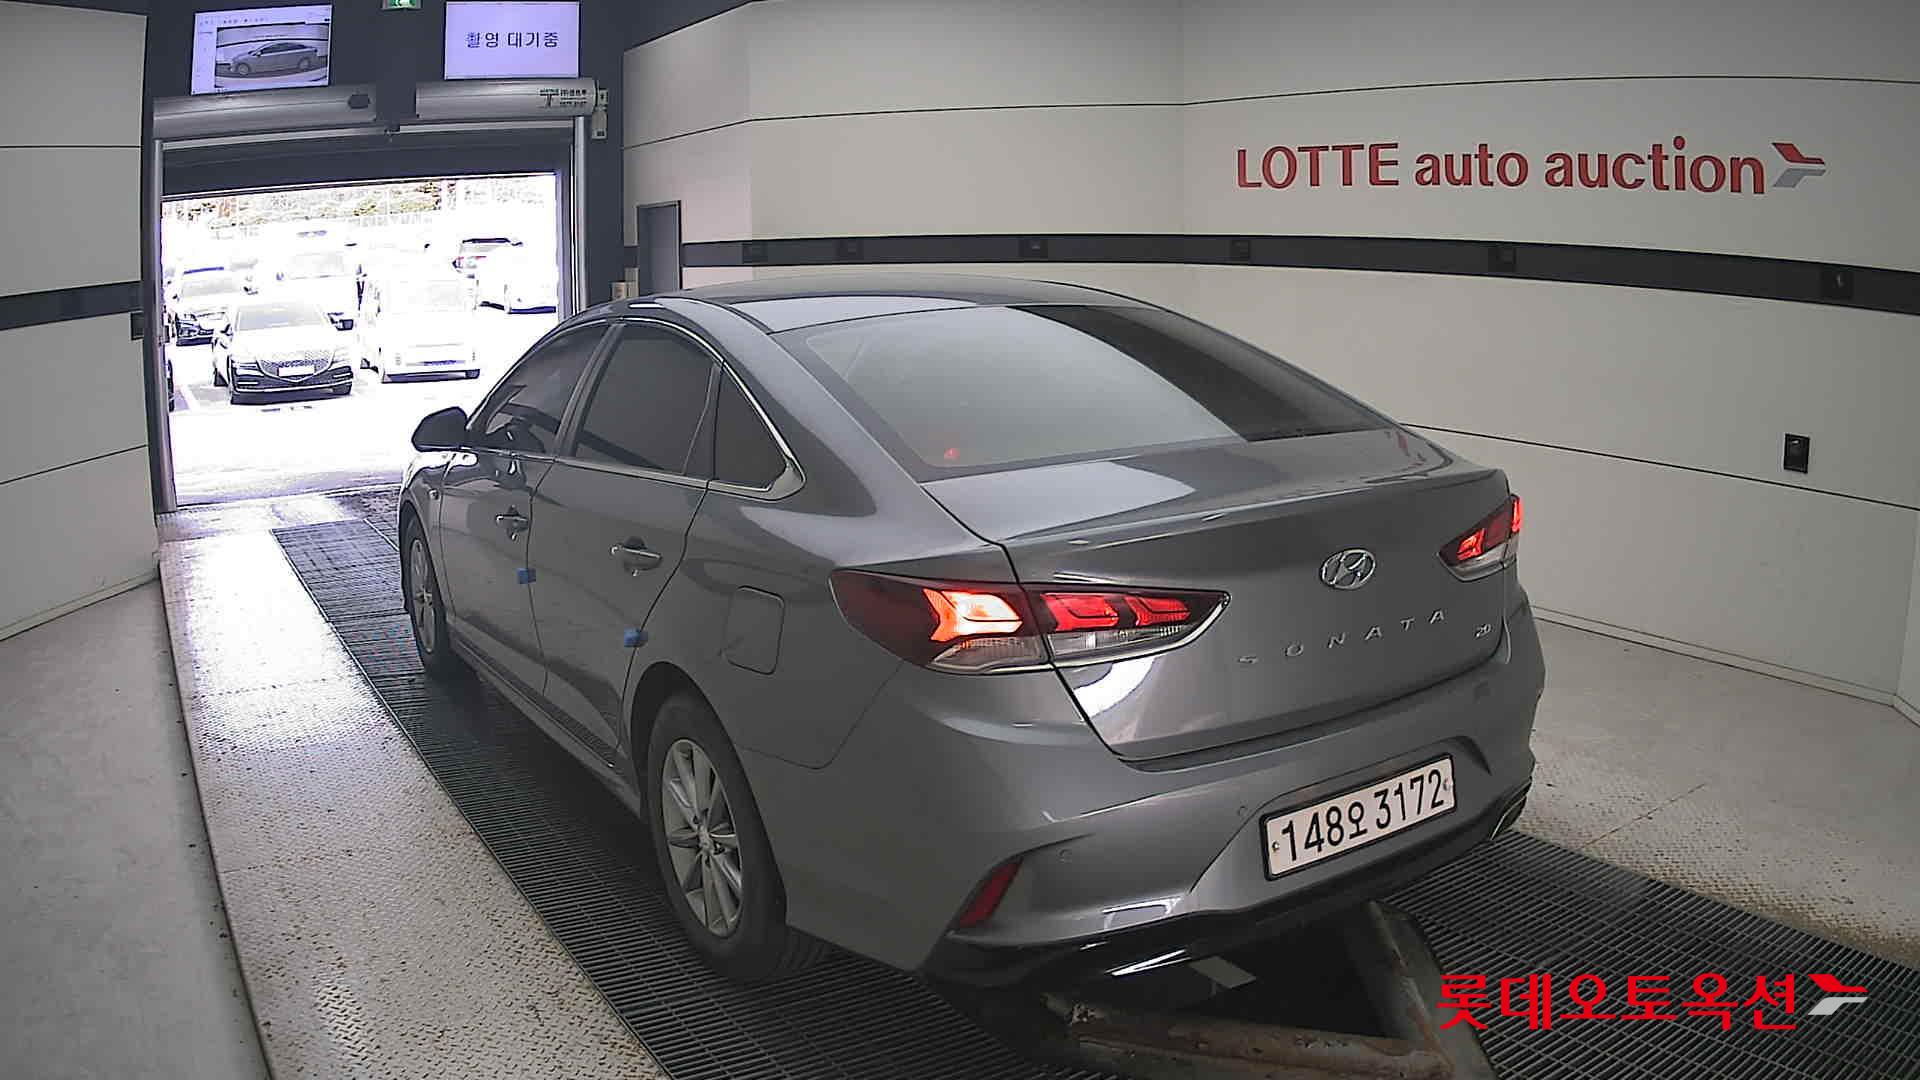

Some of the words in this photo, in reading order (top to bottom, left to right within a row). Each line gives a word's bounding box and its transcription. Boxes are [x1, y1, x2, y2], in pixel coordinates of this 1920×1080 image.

[467, 32, 499, 48] 촬영
[507, 31, 559, 48] 대기중
[1237, 143, 1399, 189] LOTTE
[1415, 143, 1530, 187] auto
[1544, 136, 1766, 195] auction
[1238, 609, 1446, 664] SONATA
[1373, 769, 1445, 829] 3172
